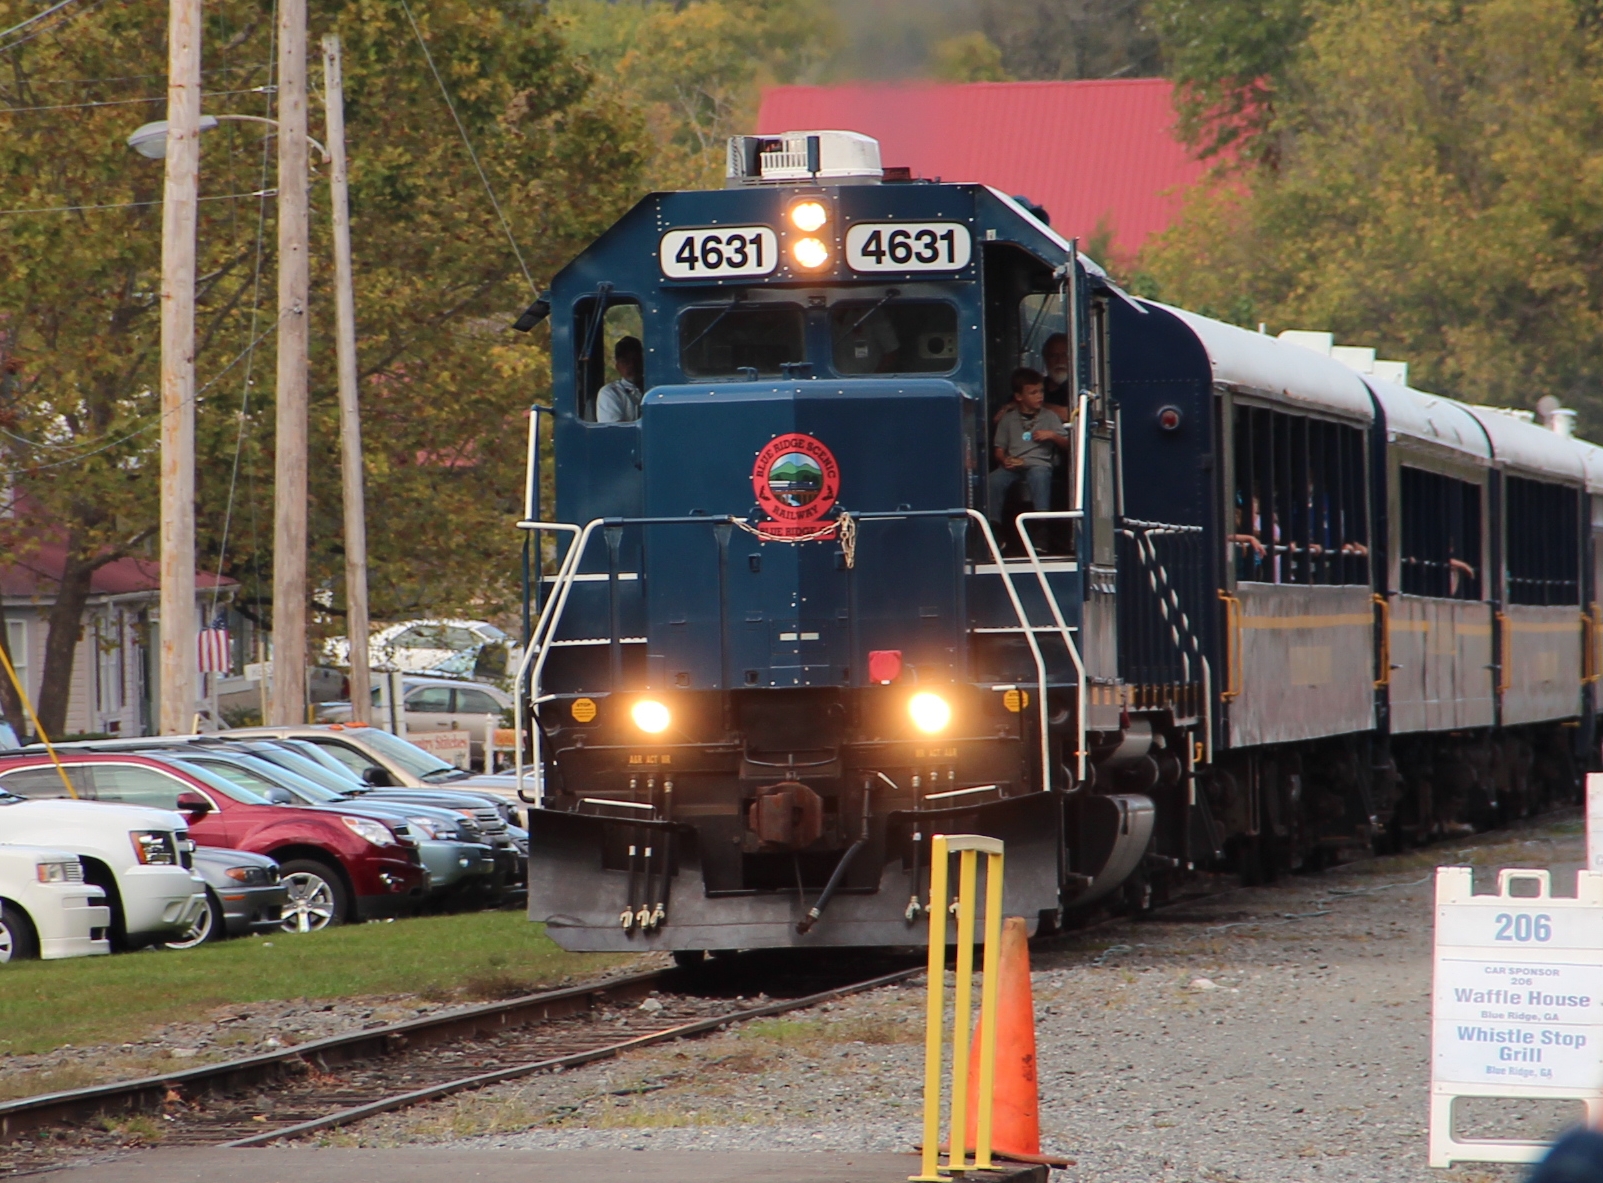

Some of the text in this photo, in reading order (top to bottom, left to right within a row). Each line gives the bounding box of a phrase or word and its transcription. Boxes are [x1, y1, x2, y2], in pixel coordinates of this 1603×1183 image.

[675, 233, 764, 270] 4631
[861, 229, 955, 265] 4631
[756, 438, 837, 479] BLUE RIDGE SCENIC
[772, 504, 818, 520] RAILWAY
[1495, 913, 1551, 942] 206
[1484, 966, 1560, 976] CAR SPONSOR
[1510, 977, 1533, 986] 206
[1454, 988, 1591, 1007] Waffle House
[1481, 1010, 1559, 1021] Blue Ridge, GA
[1457, 1026, 1586, 1049] Whistle Stop
[1499, 1046, 1542, 1062] Grill
[1485, 1065, 1553, 1078] Blue Ridge, GA
